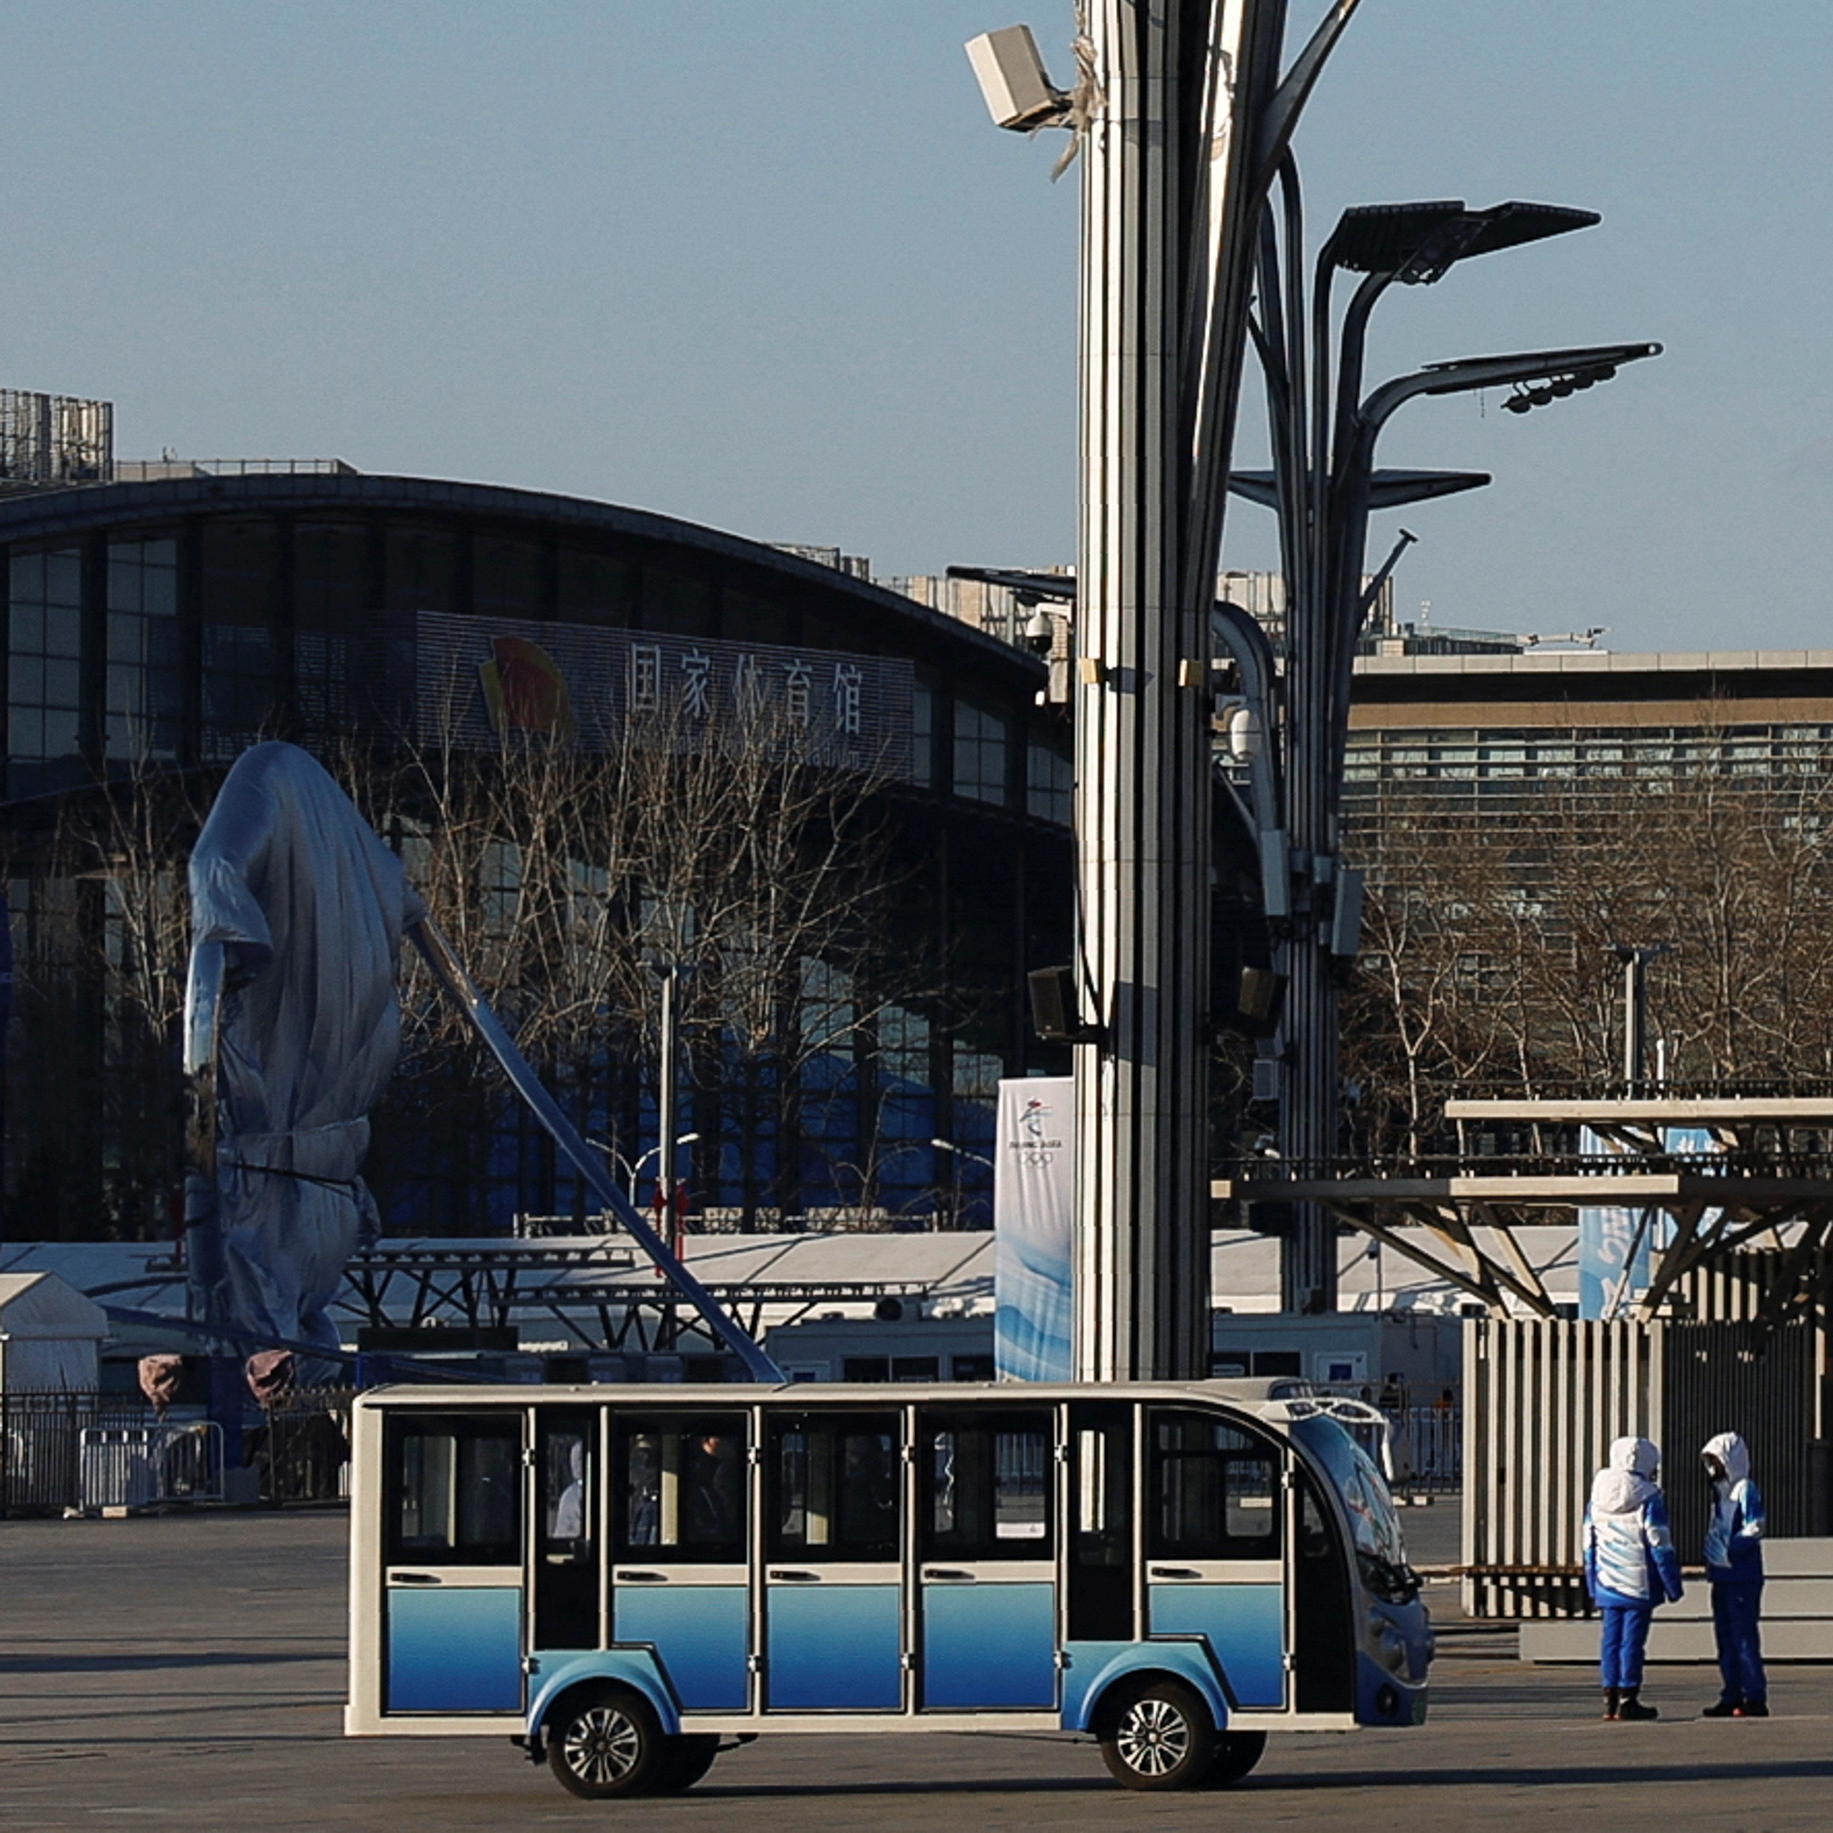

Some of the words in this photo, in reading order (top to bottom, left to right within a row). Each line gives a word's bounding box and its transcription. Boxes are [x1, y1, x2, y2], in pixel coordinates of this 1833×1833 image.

[630, 642, 863, 734] 国家体育馆
